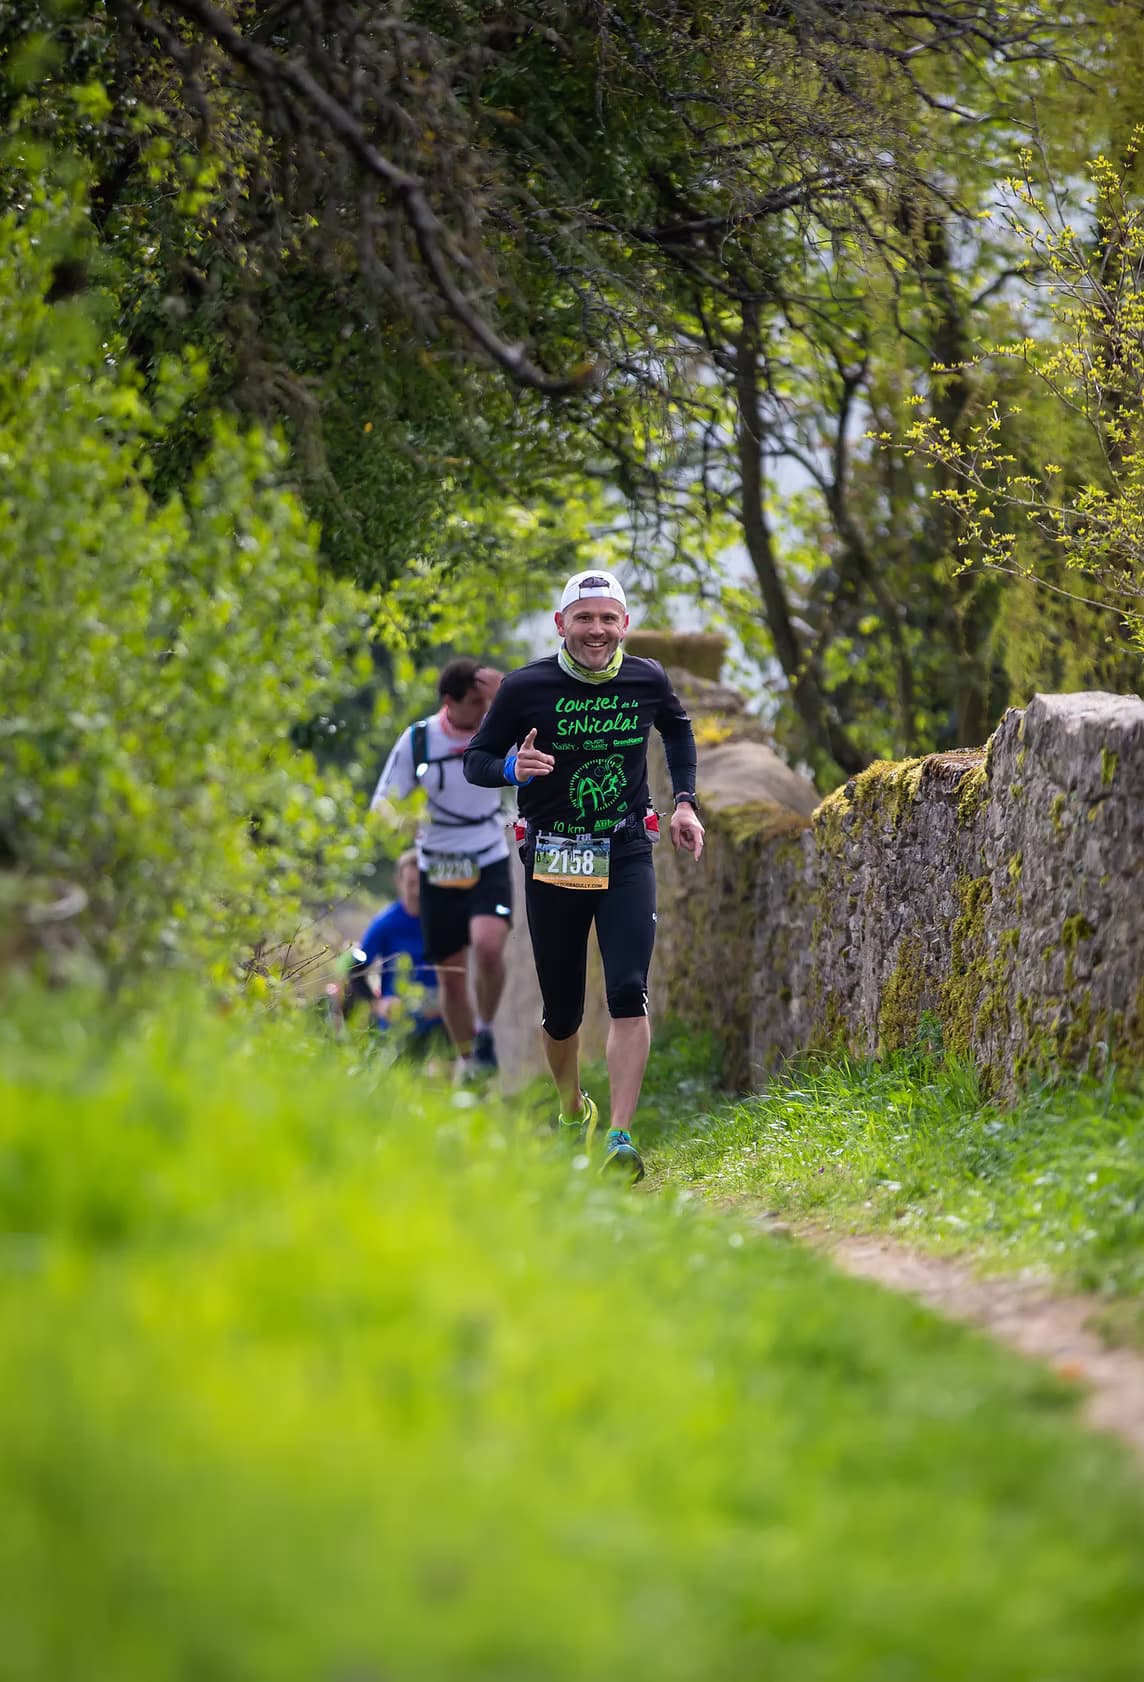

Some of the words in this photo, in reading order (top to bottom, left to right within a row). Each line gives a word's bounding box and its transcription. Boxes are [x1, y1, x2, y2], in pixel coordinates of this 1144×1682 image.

[555, 695, 618, 713] Courses
[553, 820, 565, 833] 10
[567, 823, 585, 834] km
[548, 847, 594, 875] 2158
